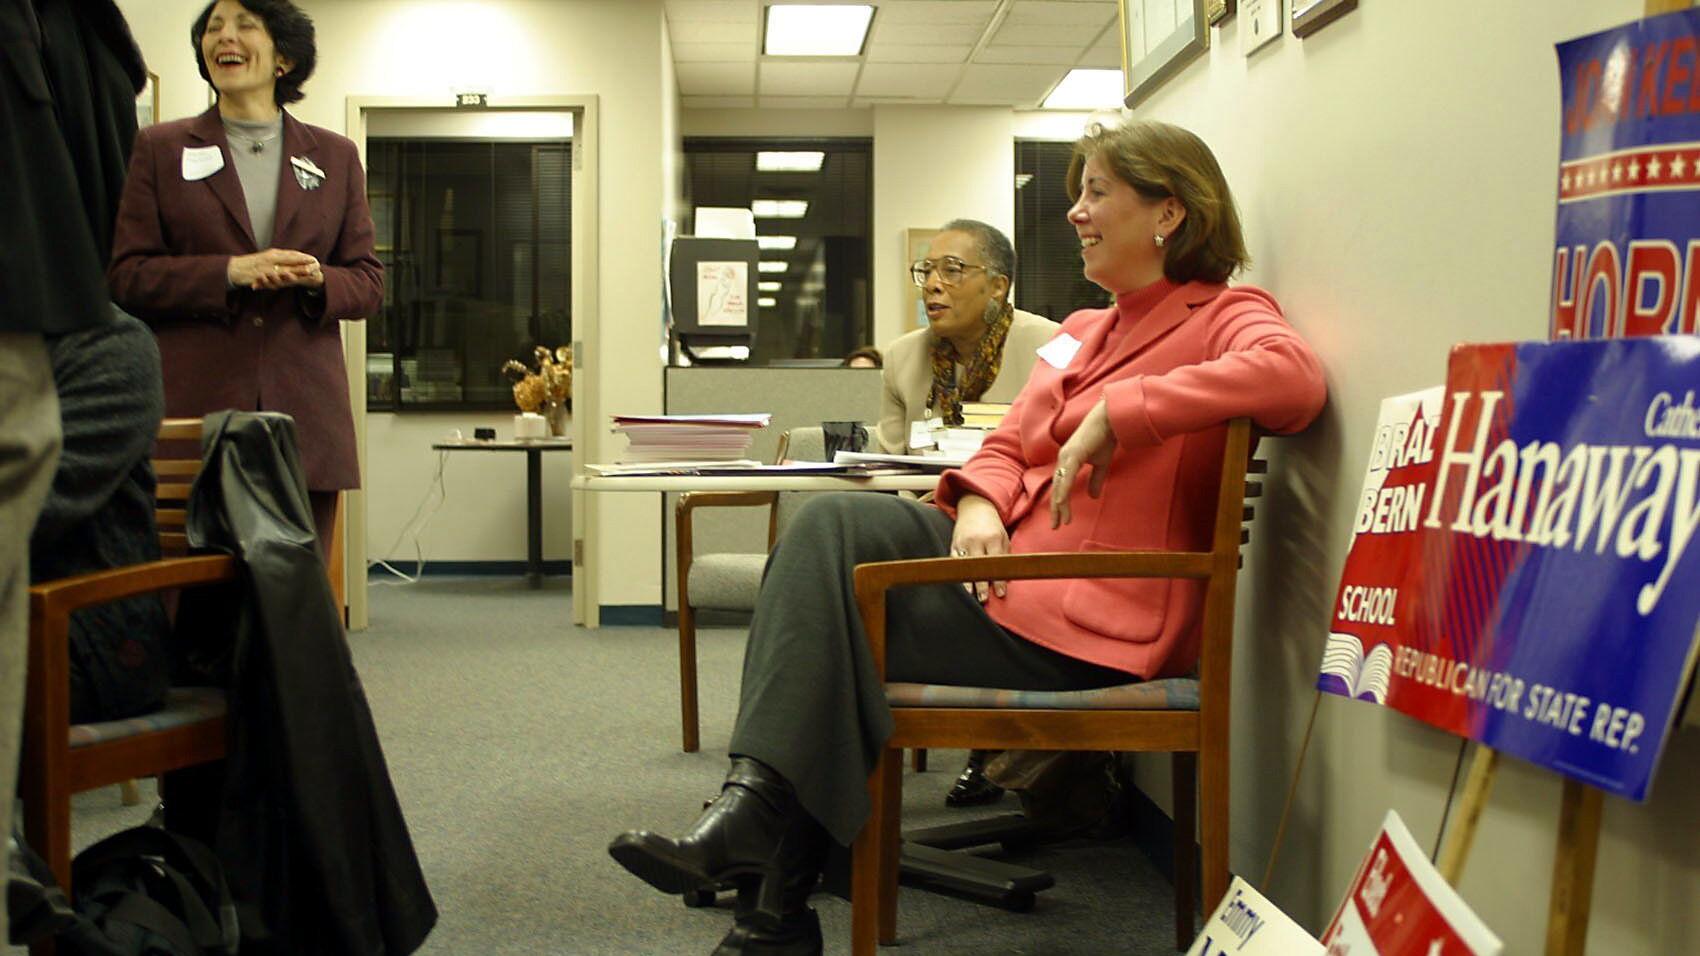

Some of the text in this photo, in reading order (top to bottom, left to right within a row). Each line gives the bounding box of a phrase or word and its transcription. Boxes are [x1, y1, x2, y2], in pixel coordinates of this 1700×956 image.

[1423, 390, 1700, 616] Hanaway
[1337, 585, 1398, 626] SCHOOL
[1393, 645, 1646, 754] REPUBLICAN FOR STATE REP.
